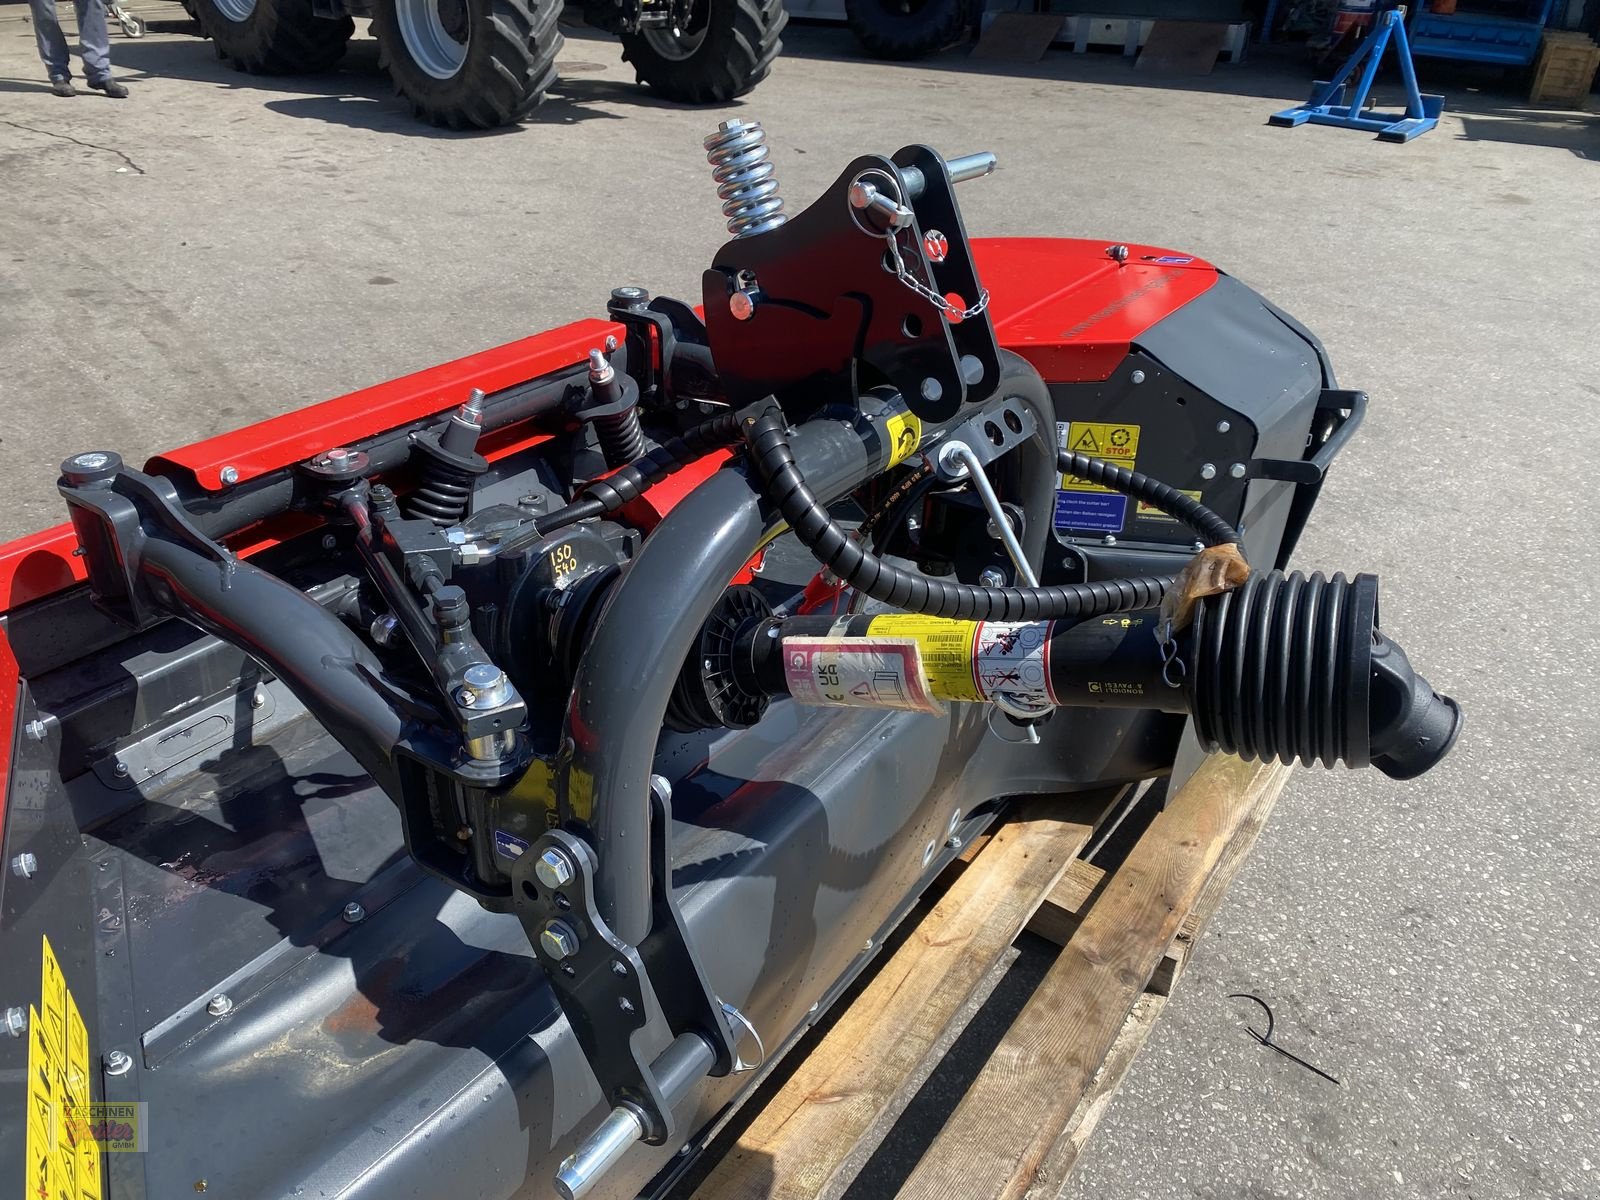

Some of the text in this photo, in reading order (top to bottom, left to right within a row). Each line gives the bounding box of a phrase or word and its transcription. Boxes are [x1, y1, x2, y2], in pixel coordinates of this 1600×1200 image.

[1105, 447, 1131, 456] STOP
[818, 664, 829, 685] UK
[828, 664, 839, 685] CA
